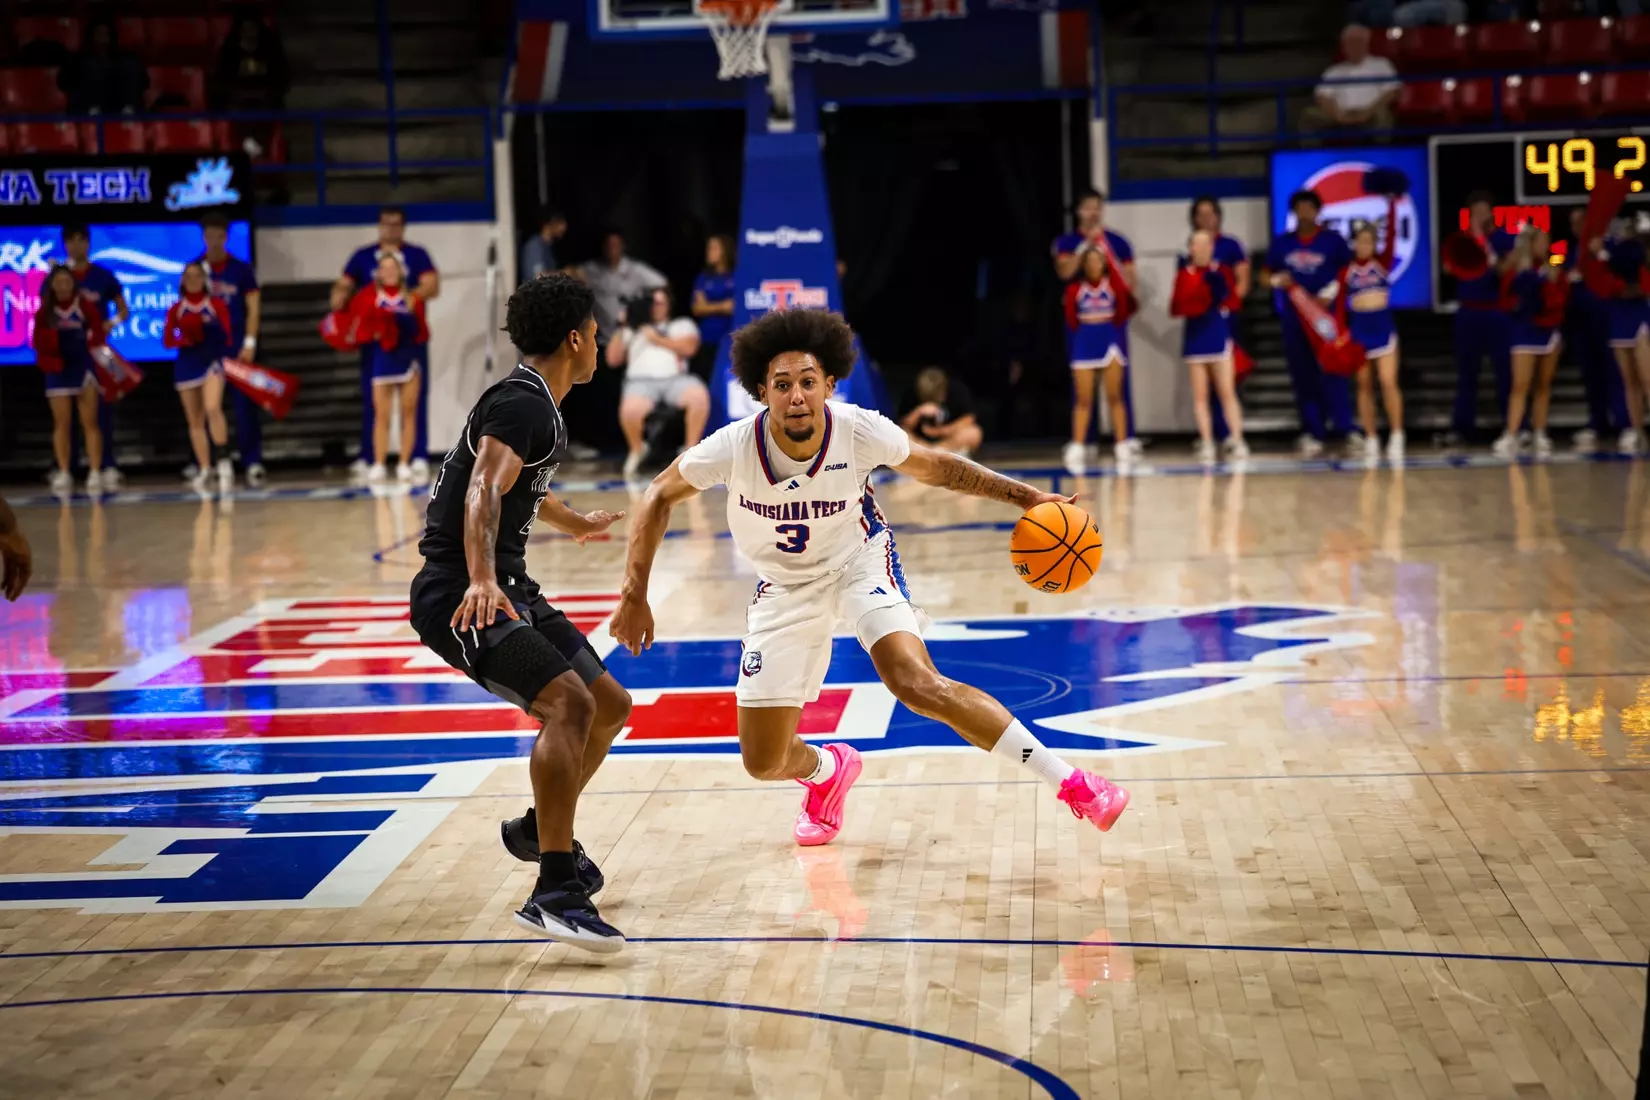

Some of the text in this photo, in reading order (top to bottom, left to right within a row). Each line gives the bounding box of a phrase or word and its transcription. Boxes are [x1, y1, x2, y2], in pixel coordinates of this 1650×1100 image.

[1525, 138, 1596, 193] 49
[46, 167, 151, 205] TECH
[739, 493, 848, 521] LOUISIANA TECH
[775, 523, 810, 554] 3
